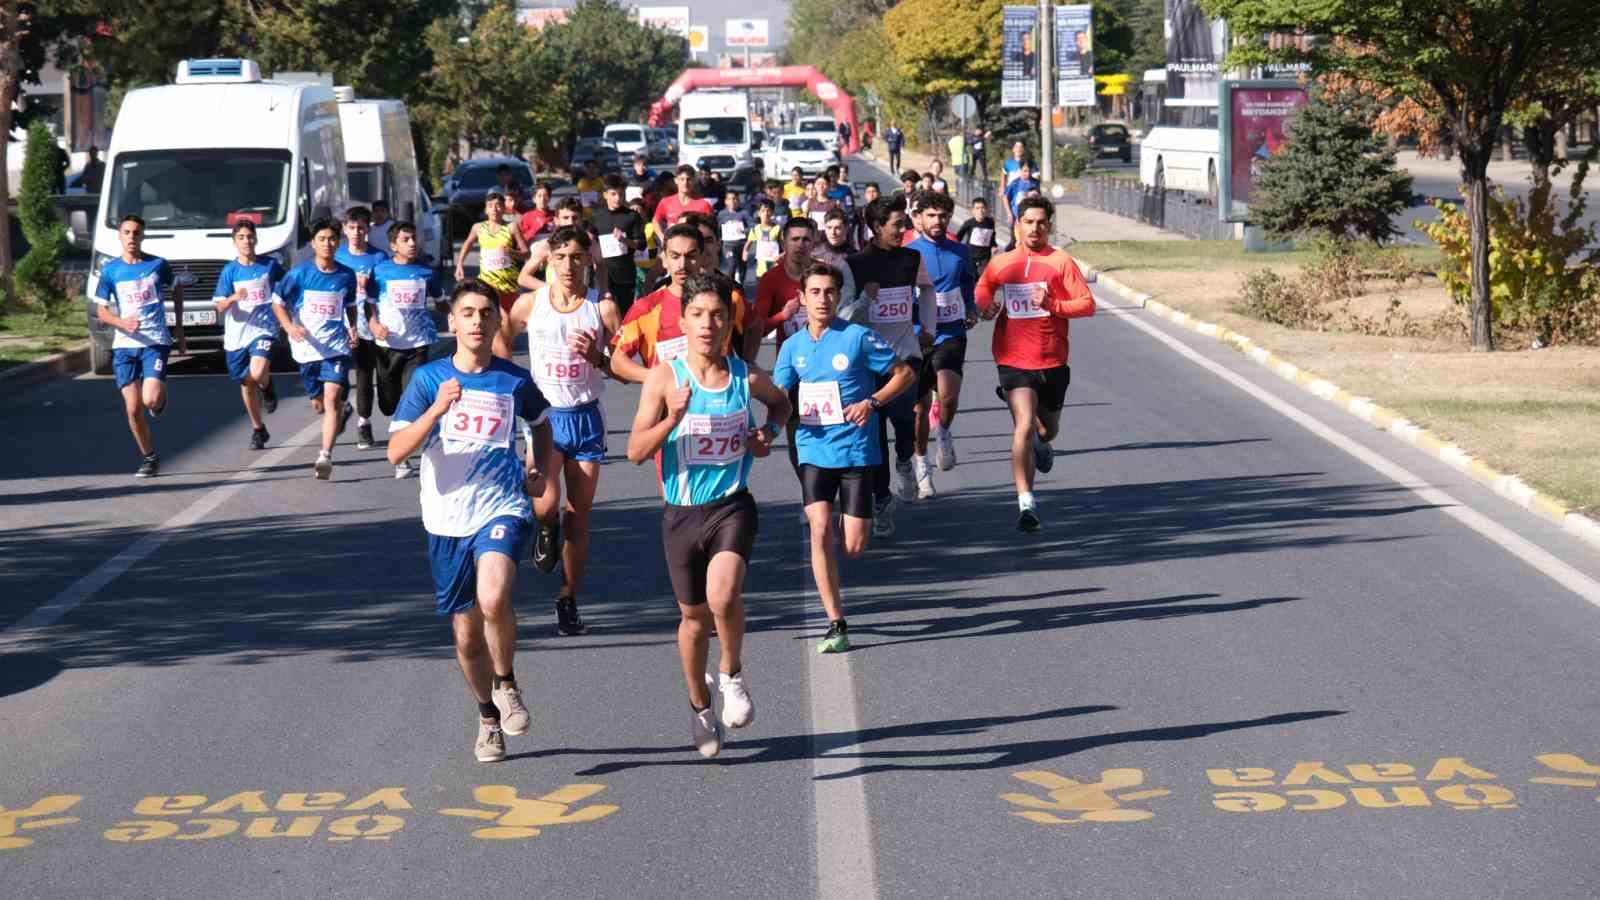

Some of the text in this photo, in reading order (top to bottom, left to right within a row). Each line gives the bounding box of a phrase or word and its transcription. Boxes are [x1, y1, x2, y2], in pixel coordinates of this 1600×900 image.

[310, 303, 337, 315] 353
[879, 302, 908, 317] 250
[545, 362, 580, 378] 198
[803, 401, 833, 417] 244
[453, 412, 503, 436] 317
[698, 434, 741, 455] 276
[490, 524, 507, 539] 6
[1206, 757, 1496, 787] yaya
[132, 787, 415, 816] yaya
